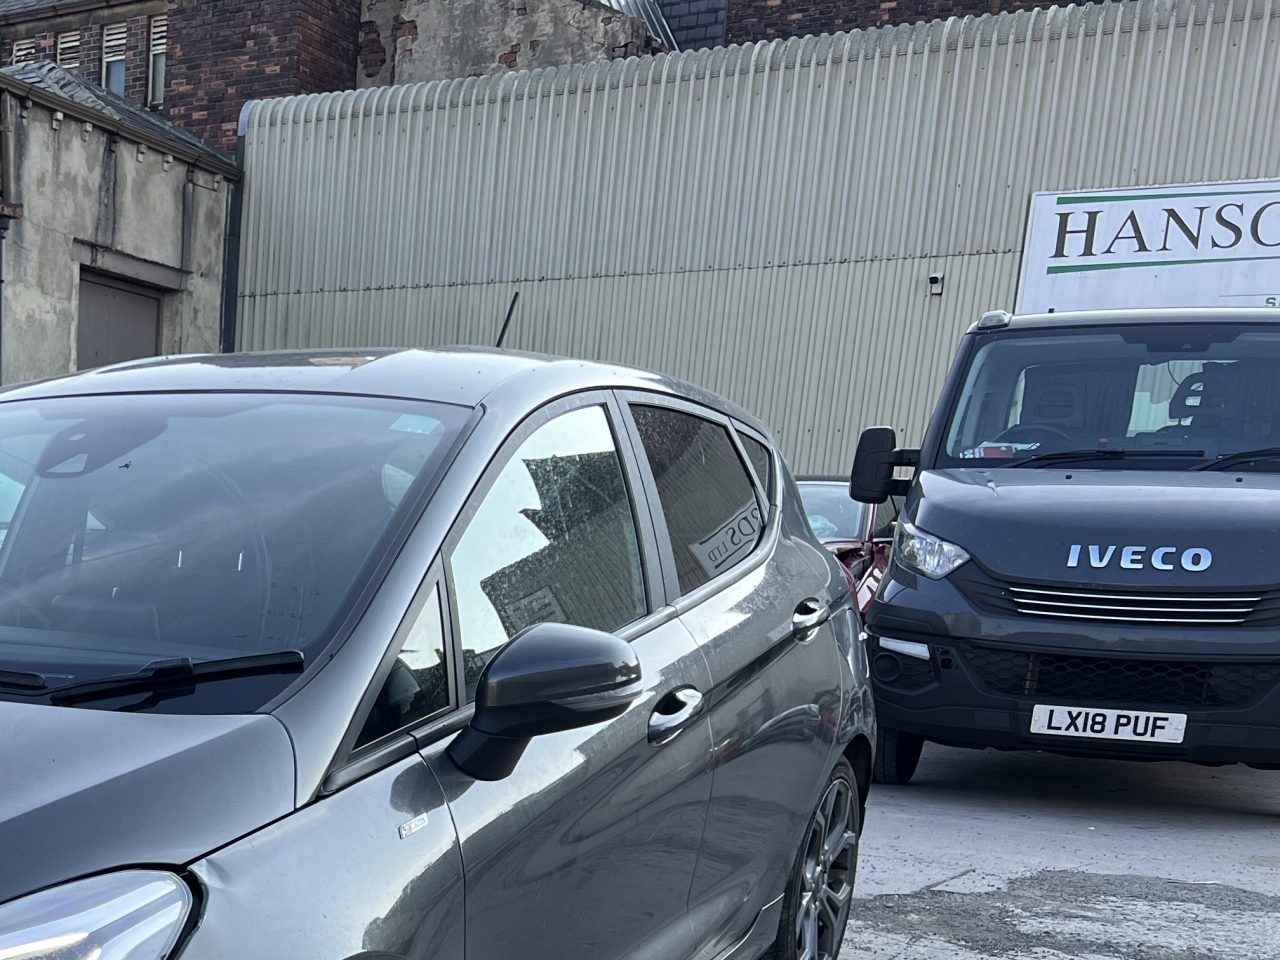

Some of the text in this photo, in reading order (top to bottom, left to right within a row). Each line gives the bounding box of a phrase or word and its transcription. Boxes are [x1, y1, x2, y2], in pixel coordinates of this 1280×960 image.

[1066, 544, 1212, 572] IVECO
[1046, 709, 1170, 738] LX18 PUF
